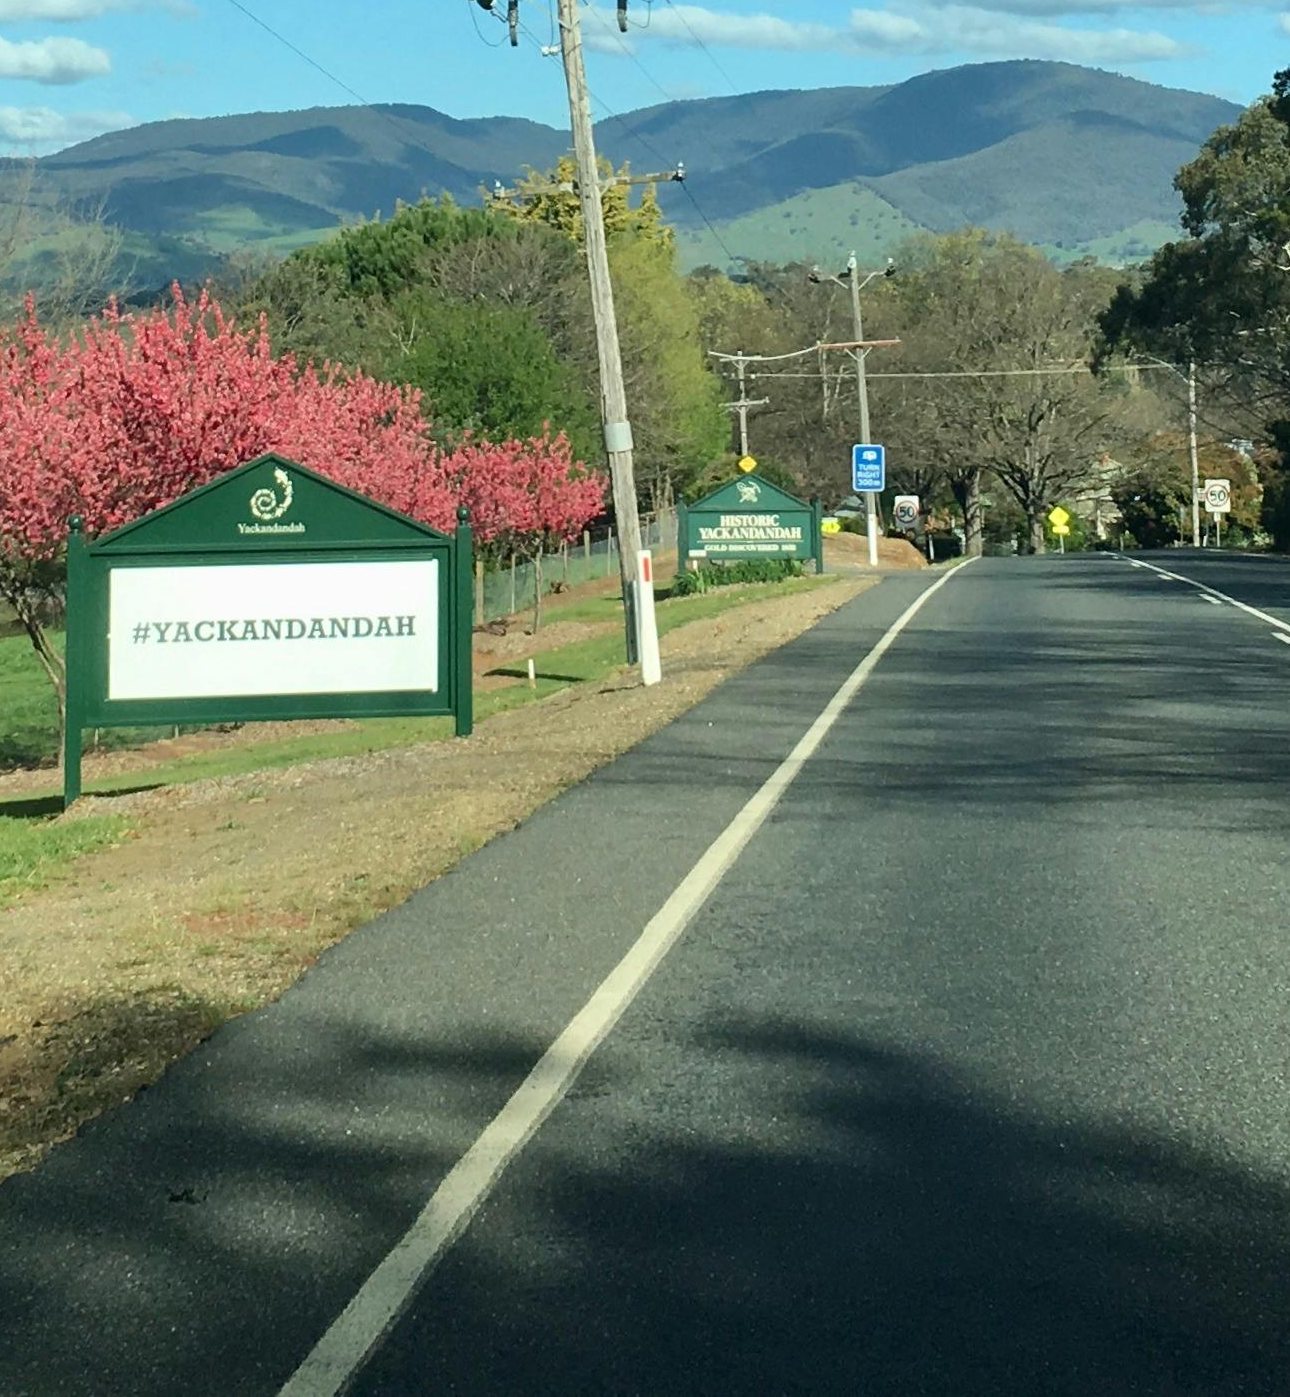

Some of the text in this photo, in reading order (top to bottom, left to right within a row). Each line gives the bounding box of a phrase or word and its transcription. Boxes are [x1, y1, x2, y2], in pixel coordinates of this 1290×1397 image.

[1210, 490, 1226, 502] 50
[899, 506, 915, 518] 50
[720, 514, 780, 527] HISTORIC
[237, 522, 305, 533] Yackandandah
[698, 527, 802, 539] YACKANDANDAH
[132, 615, 416, 644] #YACKANDANDAH
